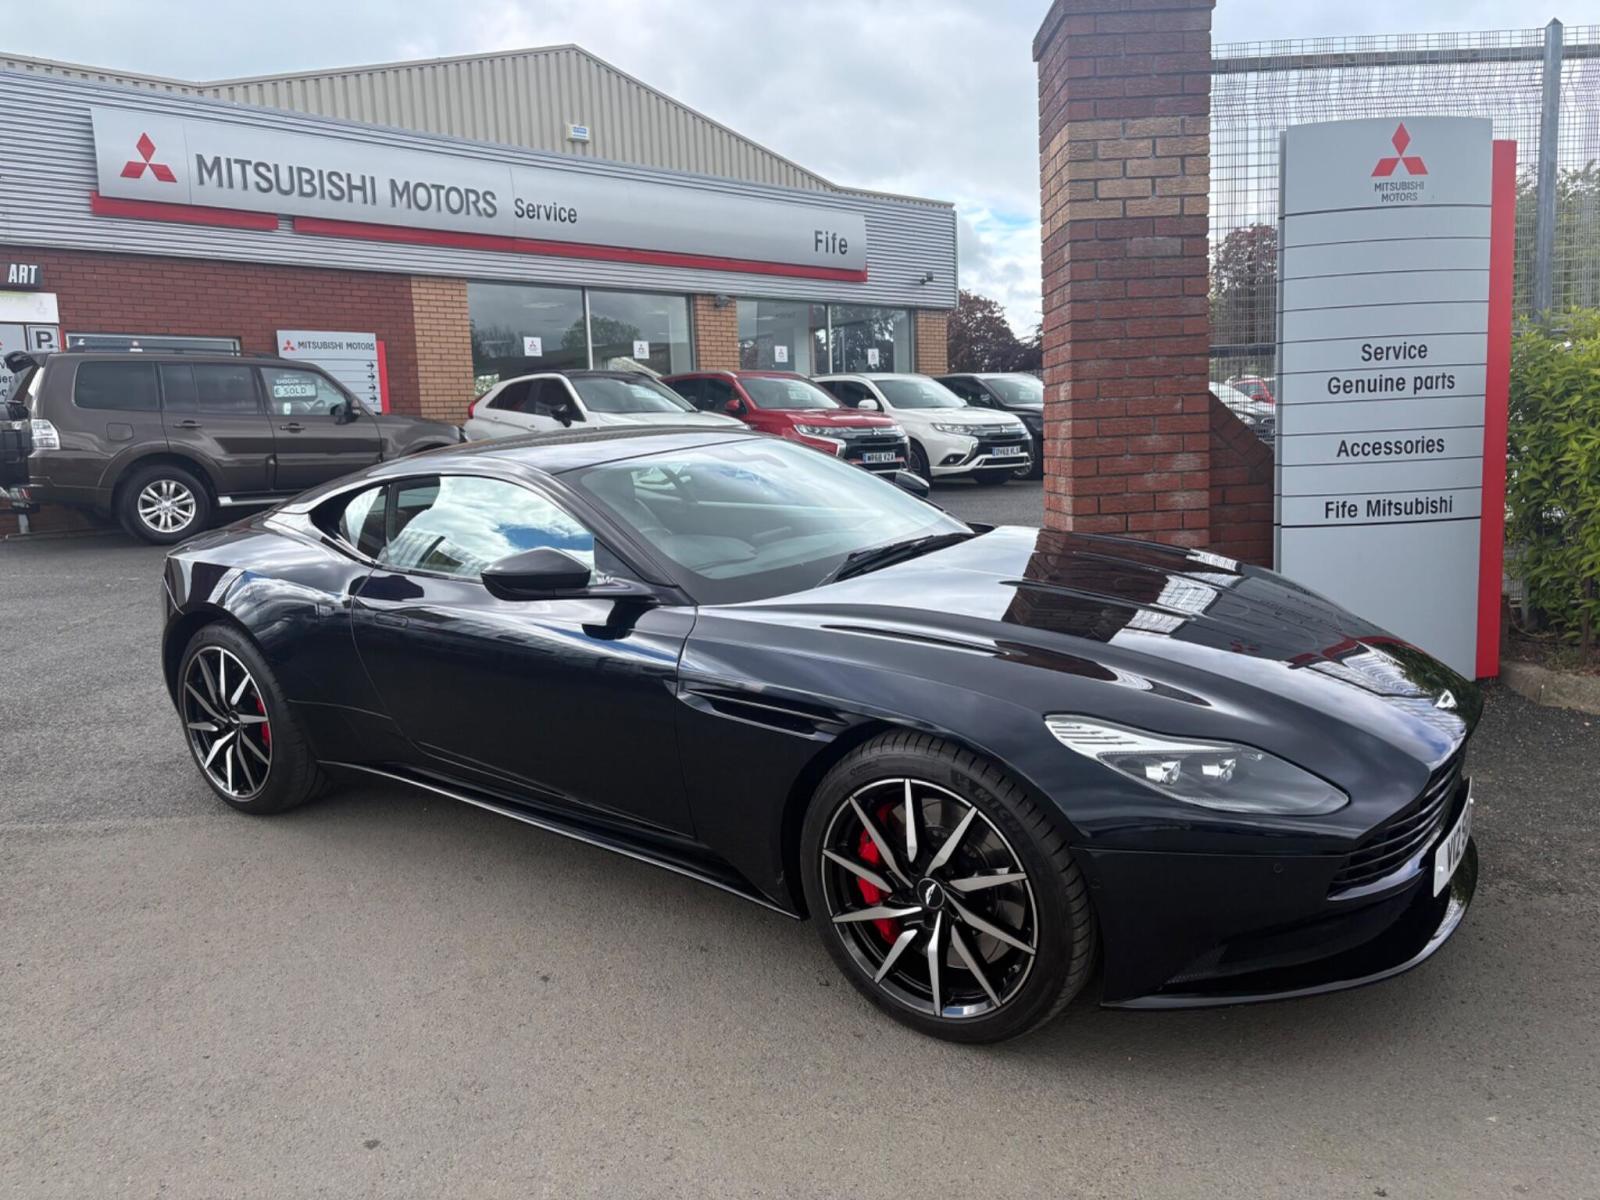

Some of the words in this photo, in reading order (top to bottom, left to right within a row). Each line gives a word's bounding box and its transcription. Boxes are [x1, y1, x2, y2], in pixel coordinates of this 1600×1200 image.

[195, 153, 378, 206] MITSUBISHI
[390, 178, 497, 218] MOTORS
[1374, 180, 1425, 192] MITSUBISHI
[1381, 192, 1418, 202] MOTORS
[514, 197, 578, 224] Service
[814, 230, 848, 255] Fife
[8, 263, 38, 284] ART
[297, 340, 344, 350] MITSUBISHI
[346, 342, 375, 351] MOTORS
[1360, 341, 1428, 362] Service
[1327, 374, 1406, 395] Genuine
[1413, 372, 1456, 395] parts
[1336, 436, 1445, 458] Accessories
[1324, 500, 1359, 519] Fife
[1366, 495, 1453, 518] Mitsubishi
